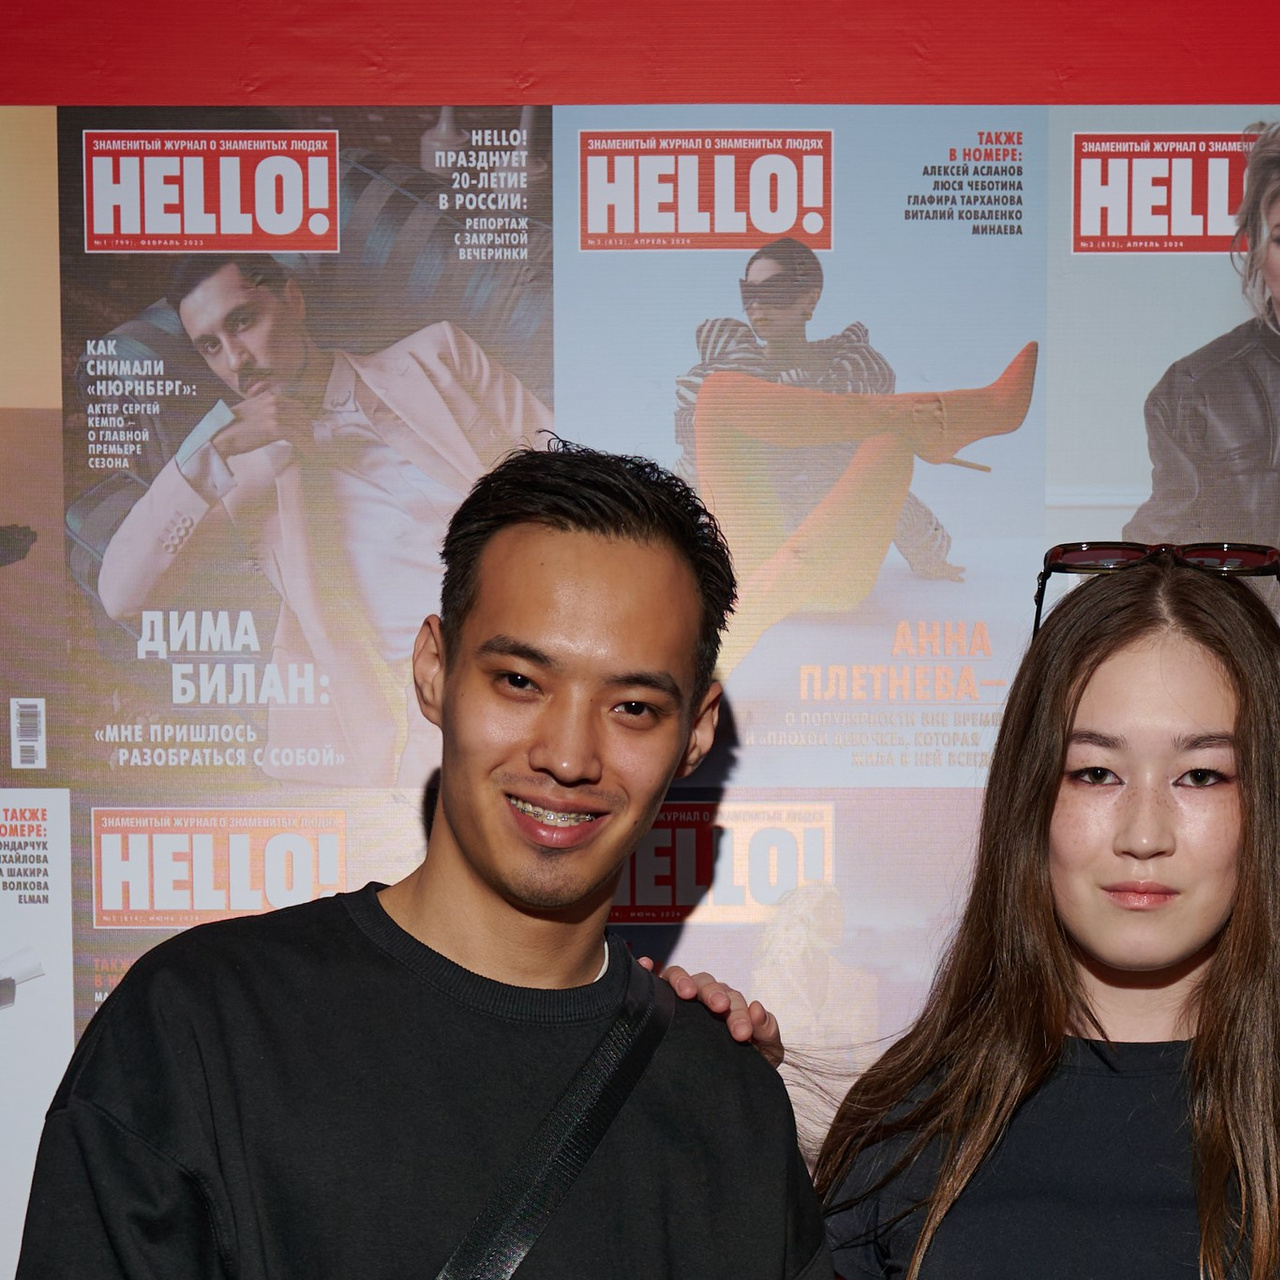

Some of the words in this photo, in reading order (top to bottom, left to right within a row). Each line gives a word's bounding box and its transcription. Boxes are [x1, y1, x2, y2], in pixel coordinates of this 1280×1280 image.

[472, 129, 527, 146] HELLO!
[588, 137, 656, 150] ЗНАМЕНИТЫЙ
[659, 139, 702, 149] ЖУРНАЛ
[714, 139, 782, 149] ЗНАМЕНИТЫХ
[785, 139, 823, 150] ЛЮДЯХ
[978, 132, 1023, 145] ТАКЖЕ
[92, 139, 161, 150] ЗНАМЕНИТЫЙ
[164, 140, 207, 150] ЖУРНАЛ
[219, 140, 287, 150] ЗНАМЕНИТЫХ
[290, 140, 328, 152] ЛЮДЯХ
[1082, 141, 1150, 152] ЗНАМЕНИТЫЙ
[1153, 142, 1196, 152] ЖУРНАЛ
[435, 151, 528, 170] ПРАЗДНУЕТ
[949, 148, 957, 161] В
[962, 148, 1022, 161] НОМЕРЕ:
[923, 164, 969, 176] АЛЕКСЕЙ
[973, 166, 1023, 176] АСЛАНОВ
[452, 172, 527, 188] 20-ЛЕТИЕ
[933, 181, 963, 191] ЛЮСЯ
[968, 181, 1023, 191] ЧЕБОТИНА
[92, 156, 330, 235] HELLO!
[587, 154, 824, 234] HELLO!
[907, 195, 957, 205] ГЛАФИРА
[960, 195, 1023, 205] ТАРХАНОВА
[1081, 158, 1248, 236] HELL
[439, 194, 448, 210] В
[455, 193, 527, 210] РОССИИ:
[905, 208, 954, 220] ВИТАЛИЙ
[958, 210, 1022, 220] КОВАЛЕНКО
[466, 218, 528, 229] РЕПОРТАЖ
[972, 225, 1023, 235] МИНАЕВА
[464, 231, 527, 244] ЗАКРЫТОЙ
[459, 248, 527, 259] ВЕЧЕРИНКИ
[87, 340, 117, 355] КАК
[87, 360, 164, 376] СНИМАЛИ
[87, 380, 197, 396] «НЮРНБЕРГ»:
[87, 404, 119, 414] АКТЕР
[122, 402, 160, 414] СЕРГЕЙ
[88, 417, 124, 428] КЕМПО
[100, 429, 149, 442] ГЛАВНОЙ
[88, 445, 142, 455] ПРЕМЬЕРЕ
[89, 458, 129, 468] СЕЗОНА
[137, 611, 261, 659] ДИМА
[891, 621, 992, 656] АННА
[172, 663, 330, 704] БИЛАН:
[95, 725, 143, 742] «МНЕ
[150, 725, 257, 742] ПРИШЛОСЬ
[119, 748, 246, 766] РАЗОБРАТЬСЯ
[270, 744, 344, 766] СОБОЙ»
[3, 808, 47, 821] ТАКЖЕ
[656, 812, 700, 821] ЖУРНАЛ
[101, 816, 170, 828] ЗНАМЕНИТЫЙ
[173, 817, 216, 828] ЖУРНАЛ
[229, 817, 297, 828] ЗНАМЕНИТЫХ
[7, 868, 49, 877] ШАКИРА
[101, 833, 338, 910] HELLO!
[2, 881, 49, 891] ВОЛКОВА
[18, 895, 49, 904] ELMAN
